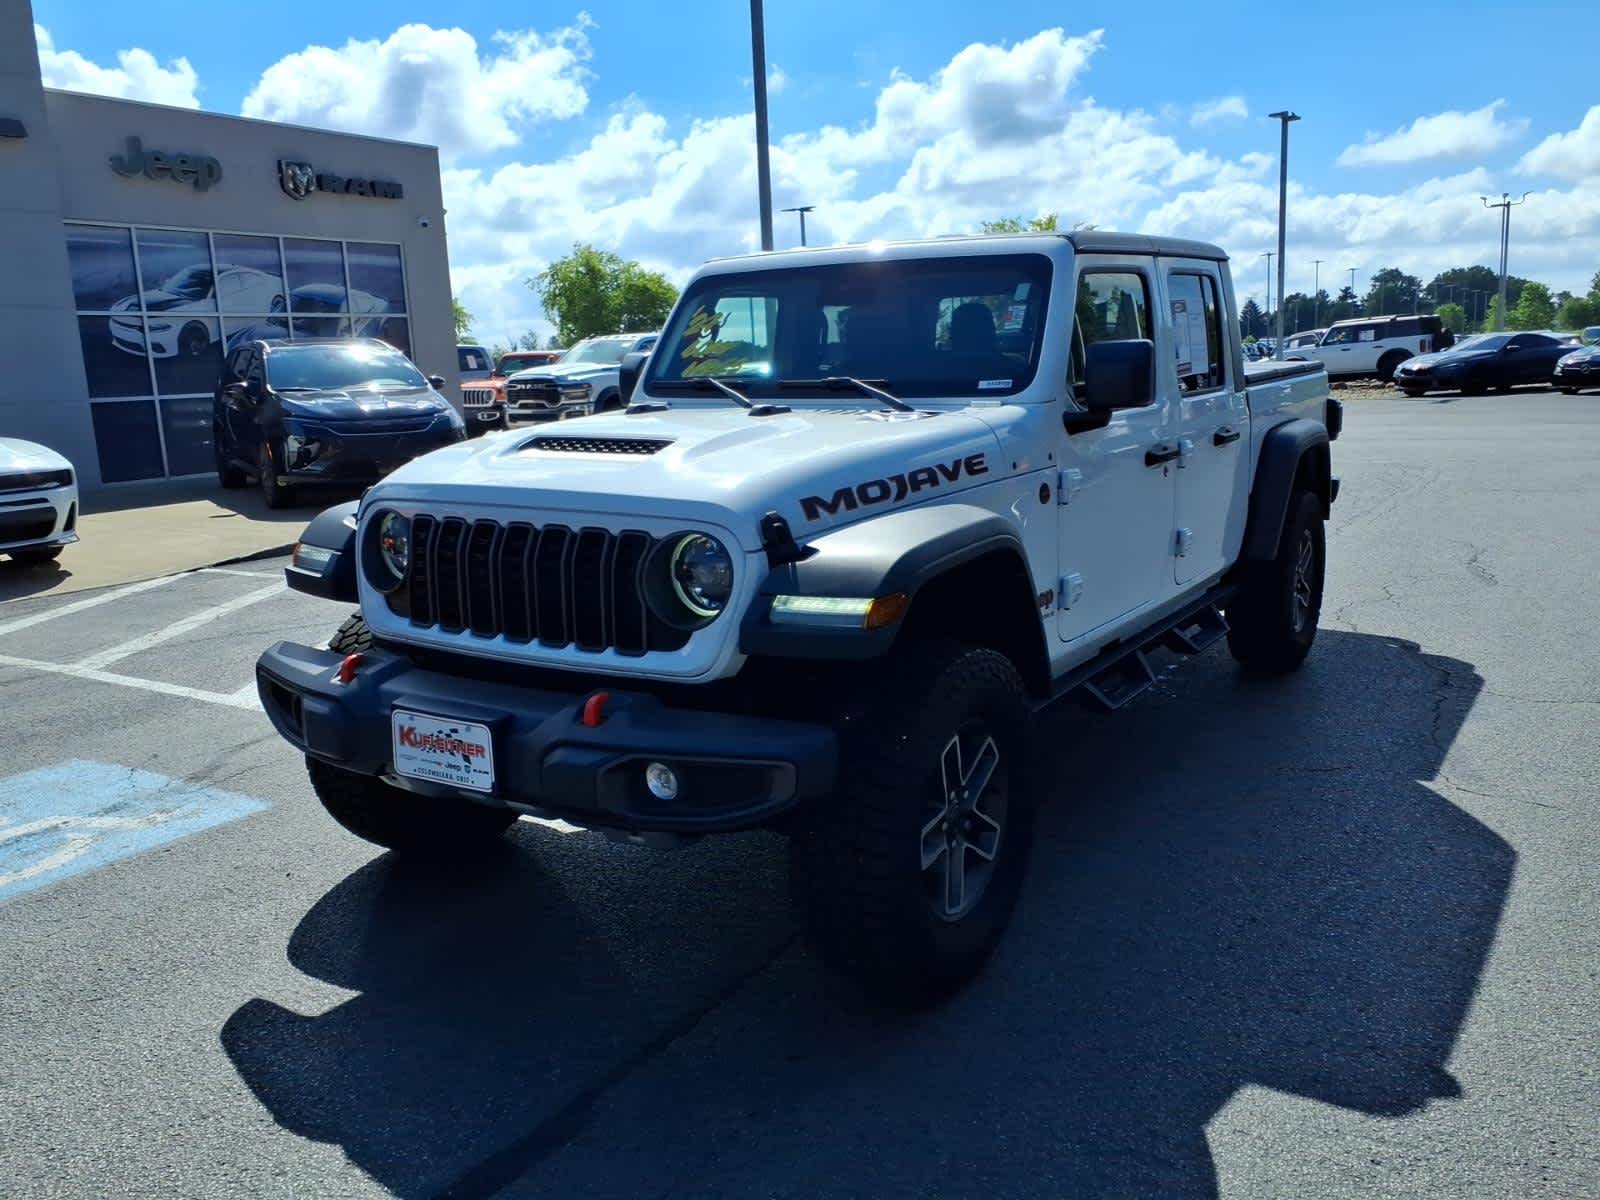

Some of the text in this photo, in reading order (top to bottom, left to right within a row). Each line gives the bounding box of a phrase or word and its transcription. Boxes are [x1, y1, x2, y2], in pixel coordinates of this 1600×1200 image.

[108, 136, 222, 192] Jeep
[316, 174, 404, 199] RAM
[799, 452, 989, 521] MOJAVE
